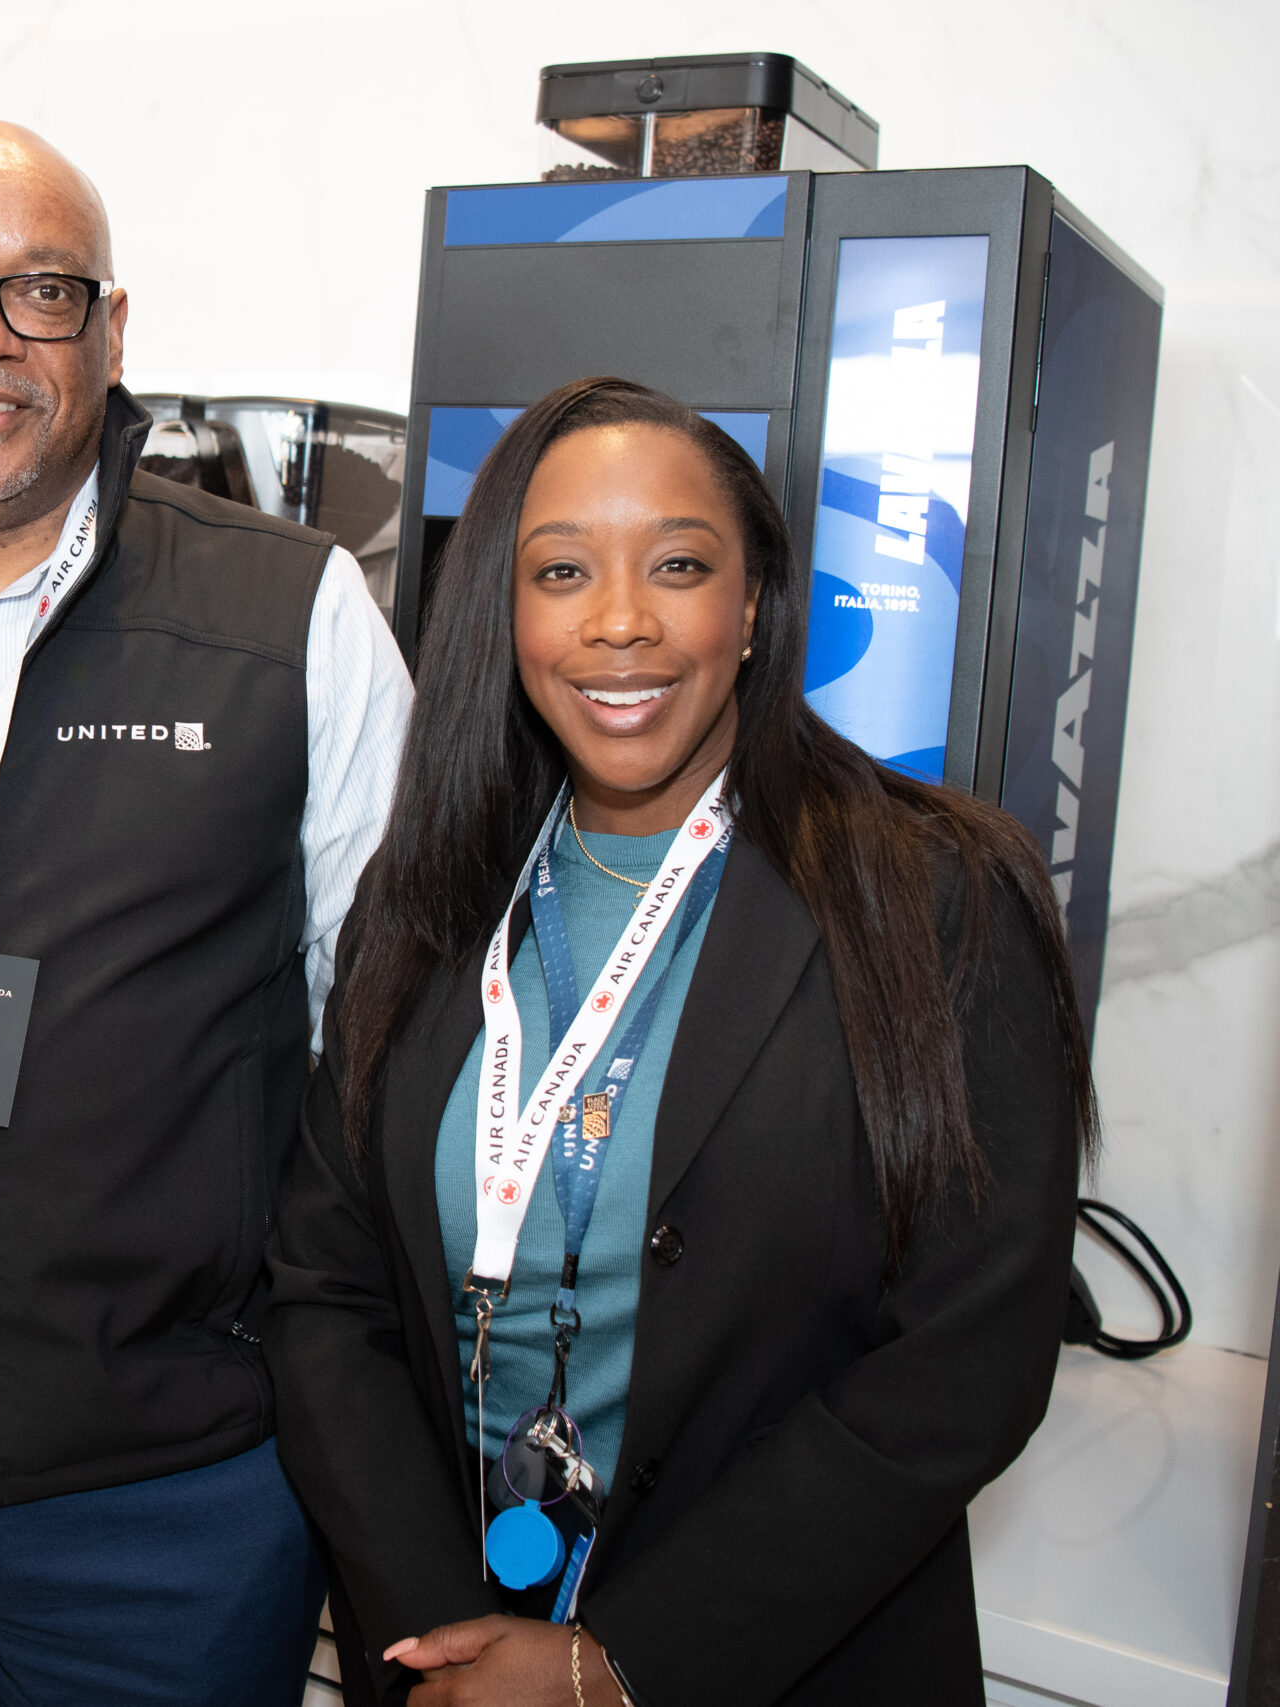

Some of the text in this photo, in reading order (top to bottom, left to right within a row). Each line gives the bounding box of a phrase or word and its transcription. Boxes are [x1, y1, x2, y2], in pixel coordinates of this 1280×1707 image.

[52, 499, 98, 592] AIR CANADA
[860, 583, 920, 599] TORINO,
[57, 725, 169, 741] UNITED
[490, 937, 501, 970] AIR
[609, 866, 685, 985] AIR CANADA
[489, 1034, 509, 1165] AIR CANADA
[513, 1042, 587, 1172] AIR CANADA
